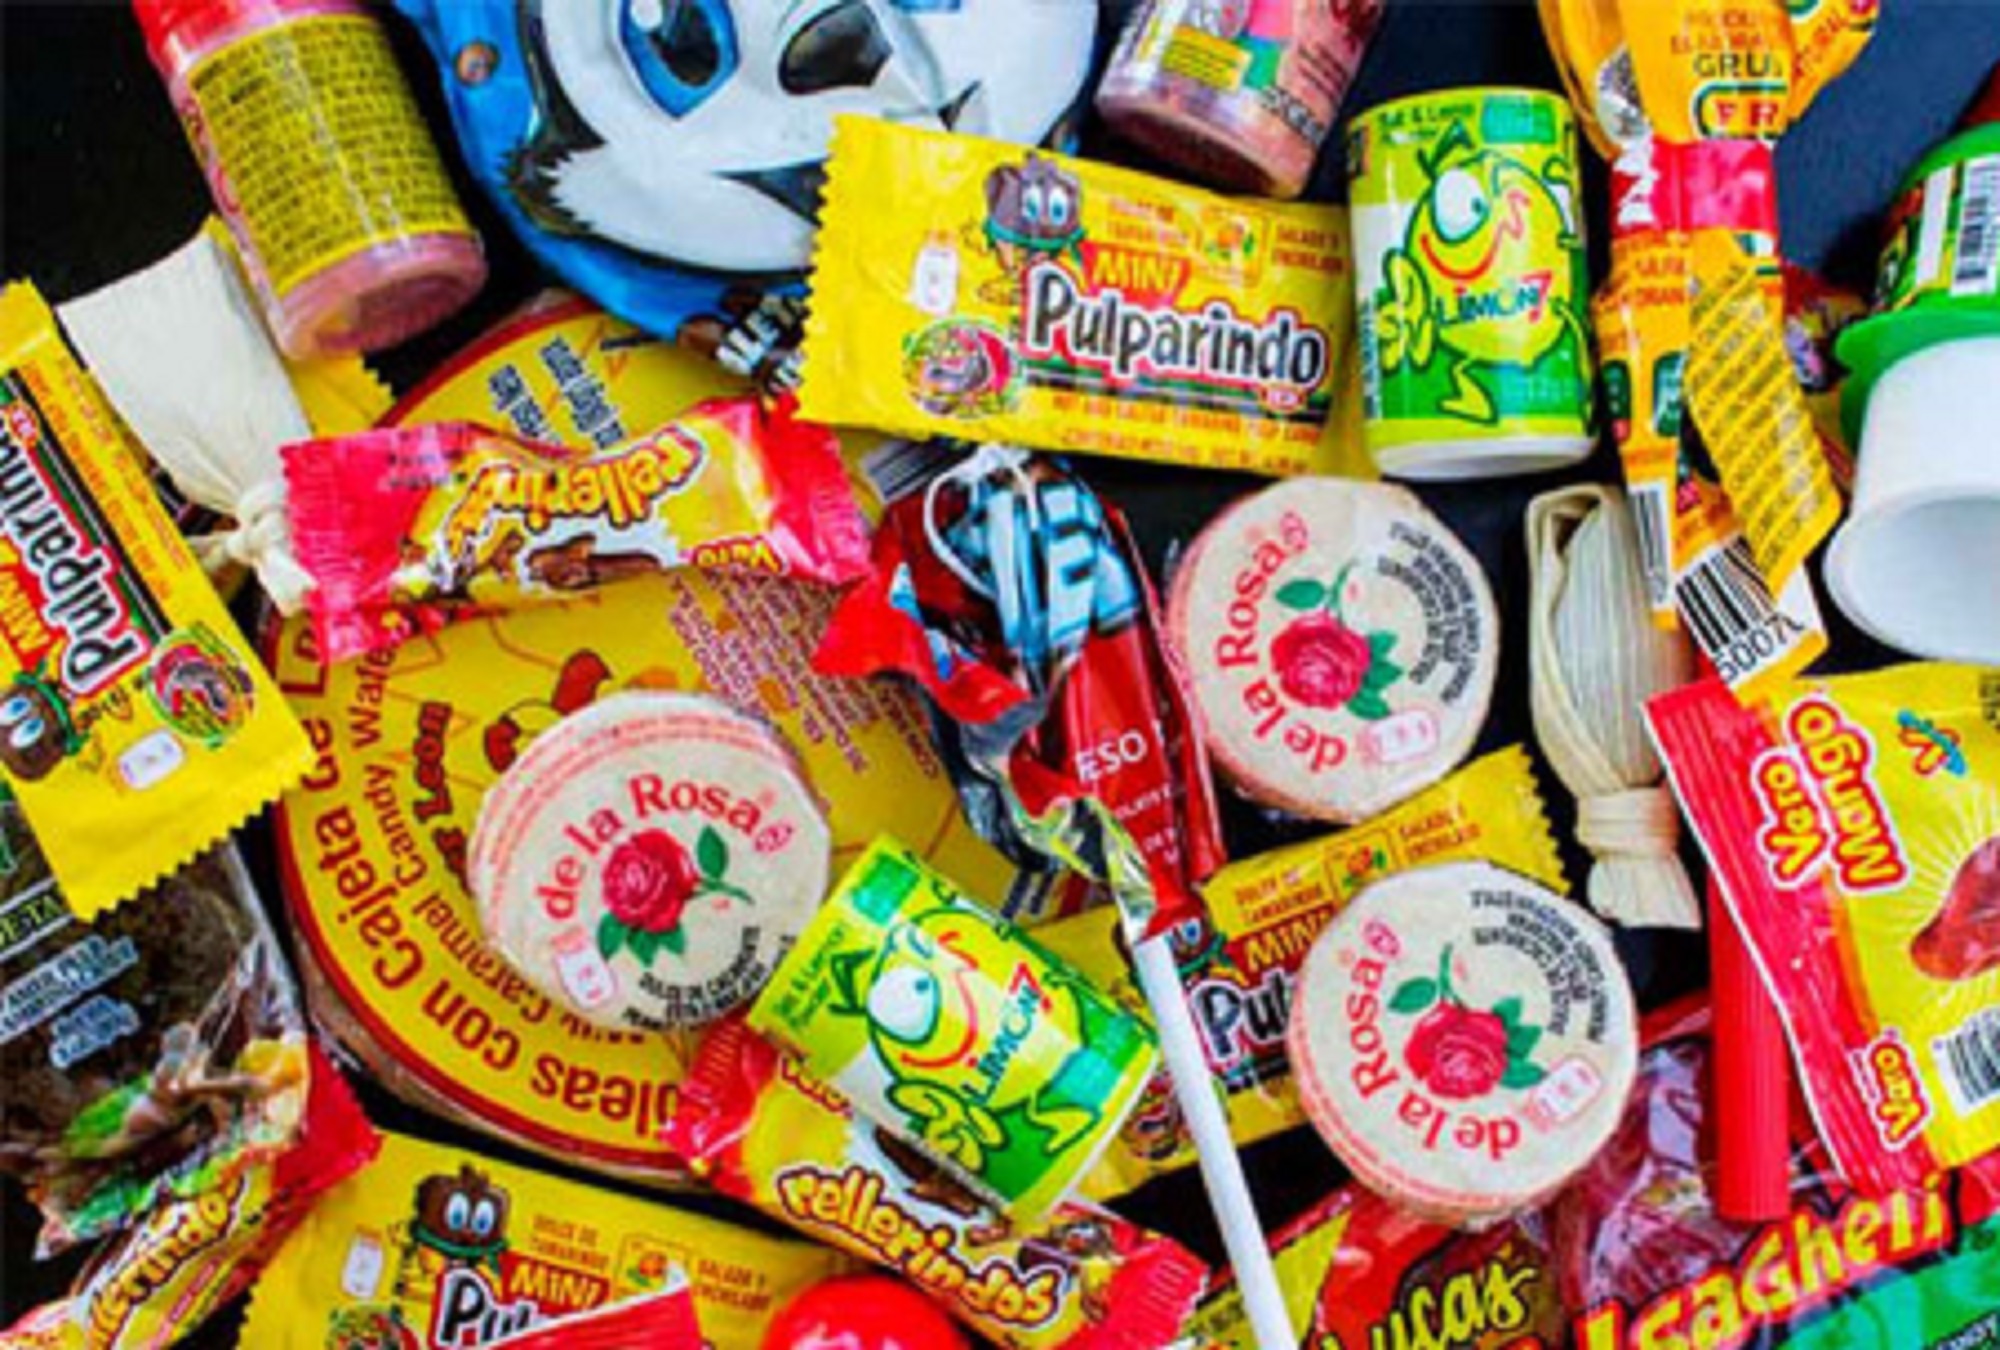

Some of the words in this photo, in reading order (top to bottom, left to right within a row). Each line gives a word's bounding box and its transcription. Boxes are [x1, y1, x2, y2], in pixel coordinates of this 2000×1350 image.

[1029, 263, 1325, 389] Pulparindo
[1094, 247, 1189, 293] MINI
[1215, 540, 1287, 668] Rosa
[1244, 679, 1288, 738] la
[1284, 721, 1349, 773] de
[363, 764, 428, 890] Candy
[536, 857, 586, 920] de
[563, 808, 624, 856] la
[629, 772, 762, 836] Rosa
[1761, 758, 1823, 877] Vero
[1794, 701, 1903, 884] Mango
[314, 805, 426, 990] Cajeta
[421, 979, 521, 1074] con
[1347, 956, 1400, 1100] Rosa
[1396, 1089, 1449, 1150] la
[1455, 1115, 1521, 1160] de
[1875, 1046, 1922, 1142] Vero
[511, 1261, 602, 1309] MINI
[777, 1165, 1061, 1323] rellerindos
